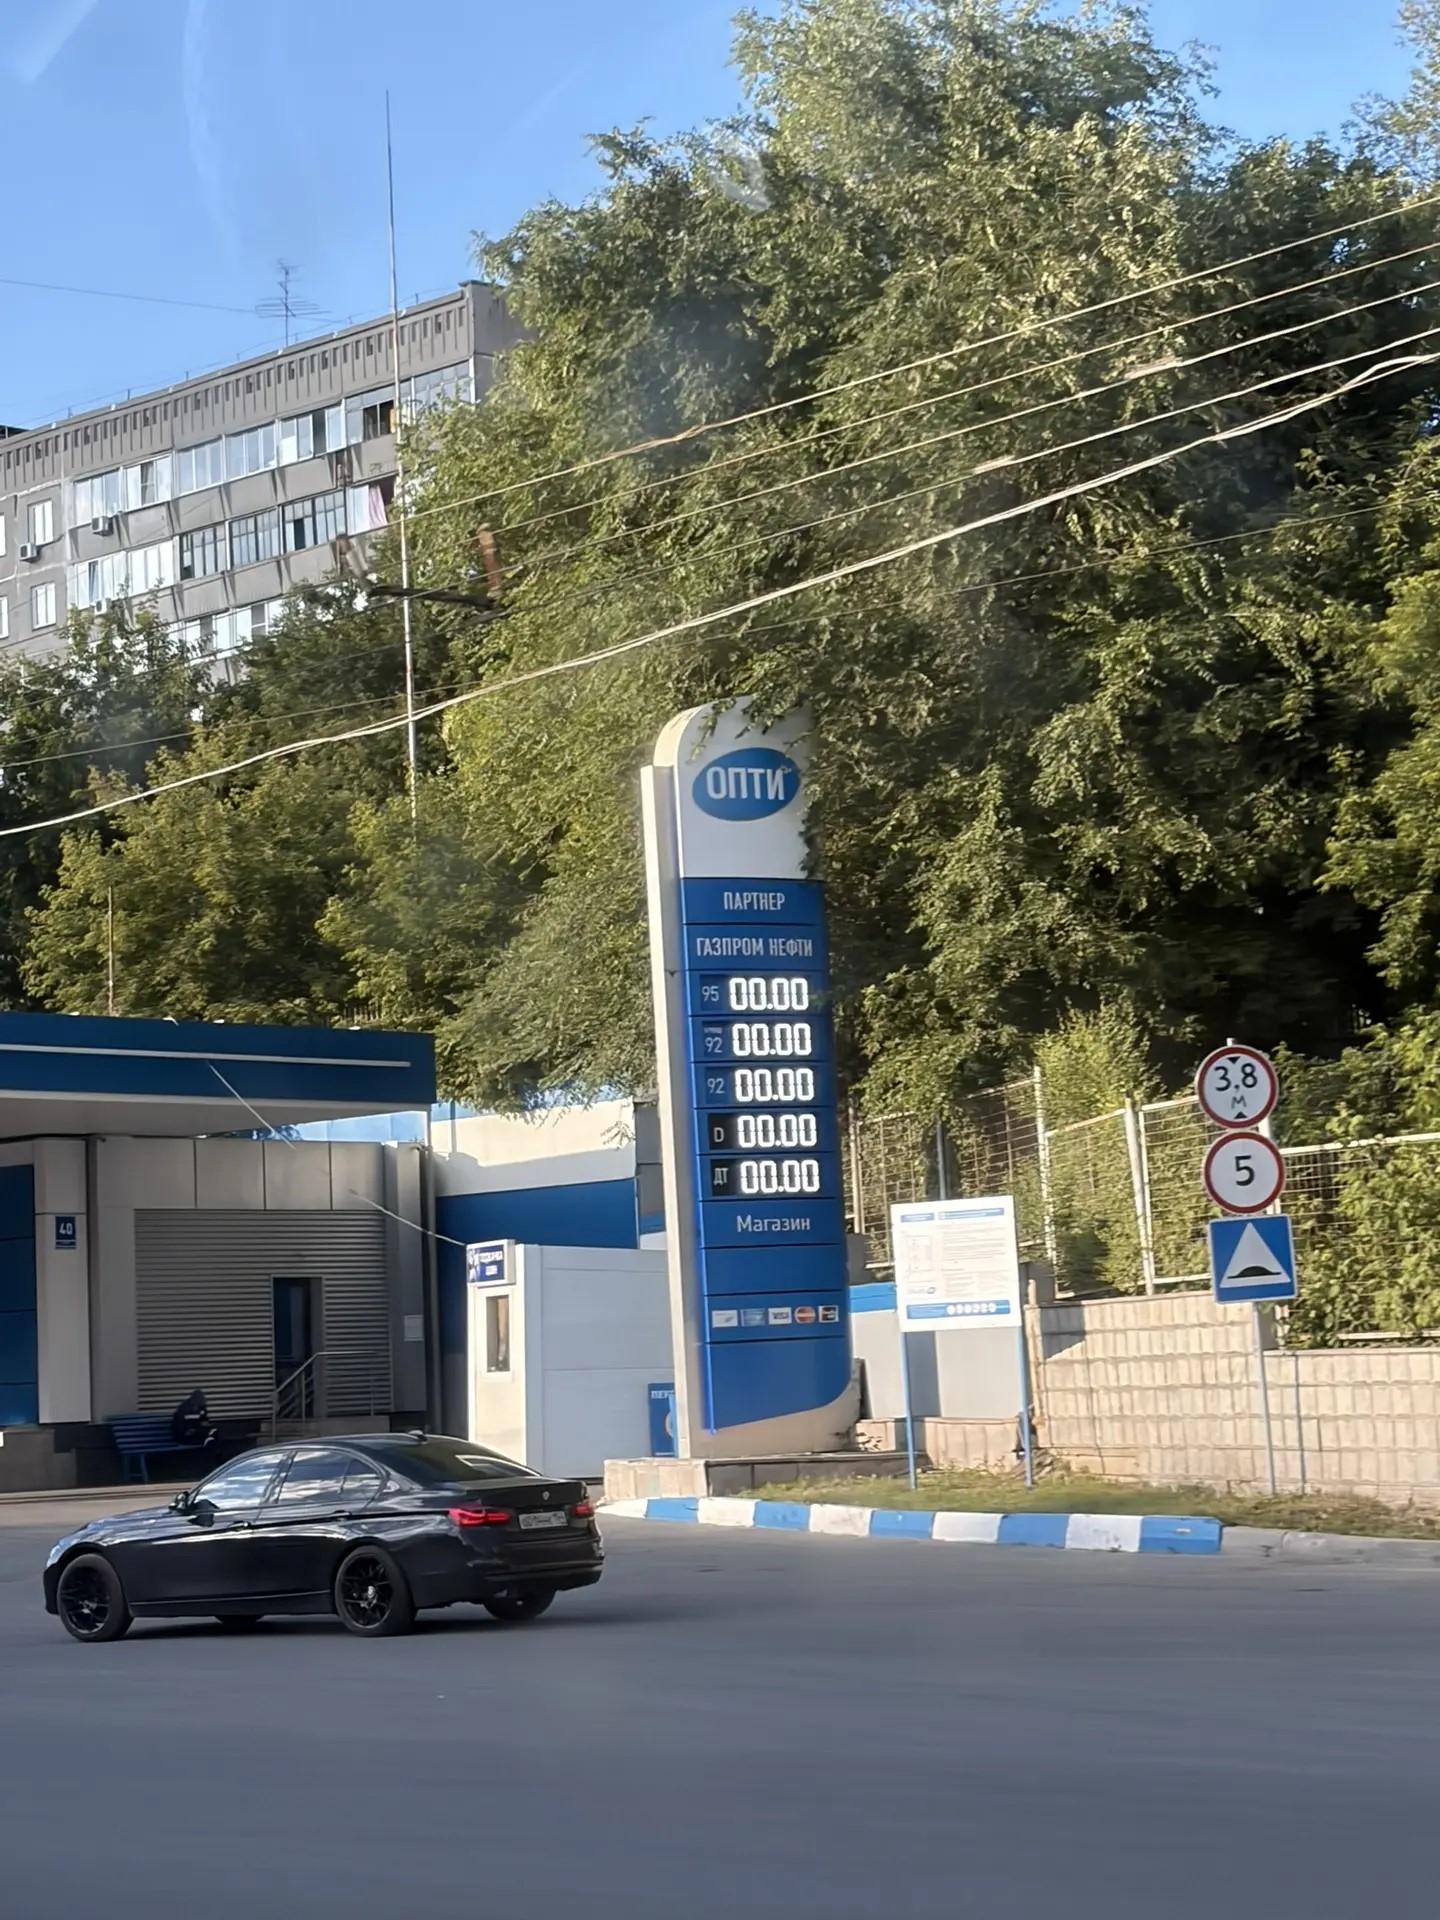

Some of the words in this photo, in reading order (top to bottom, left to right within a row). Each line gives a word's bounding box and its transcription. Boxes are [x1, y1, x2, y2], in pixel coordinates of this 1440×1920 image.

[706, 766, 785, 801] ОПТИ
[723, 891, 786, 911] ПАРТНЕР
[696, 937, 765, 957] ГАЗПРОМ
[768, 938, 814, 957] НЕФТИ
[702, 985, 720, 1002] 95
[729, 977, 810, 1011] 00.00
[705, 1036, 723, 1053] 92
[732, 1022, 813, 1057] 00.00
[707, 1078, 726, 1094] 92
[734, 1067, 816, 1101] 00.00
[737, 1113, 818, 1149] 00.00
[713, 1167, 729, 1186] ДТ
[740, 1159, 821, 1194] 00.00
[1234, 1154, 1256, 1187] 5
[59, 1222, 73, 1235] 40
[736, 1215, 811, 1233] Магазин
